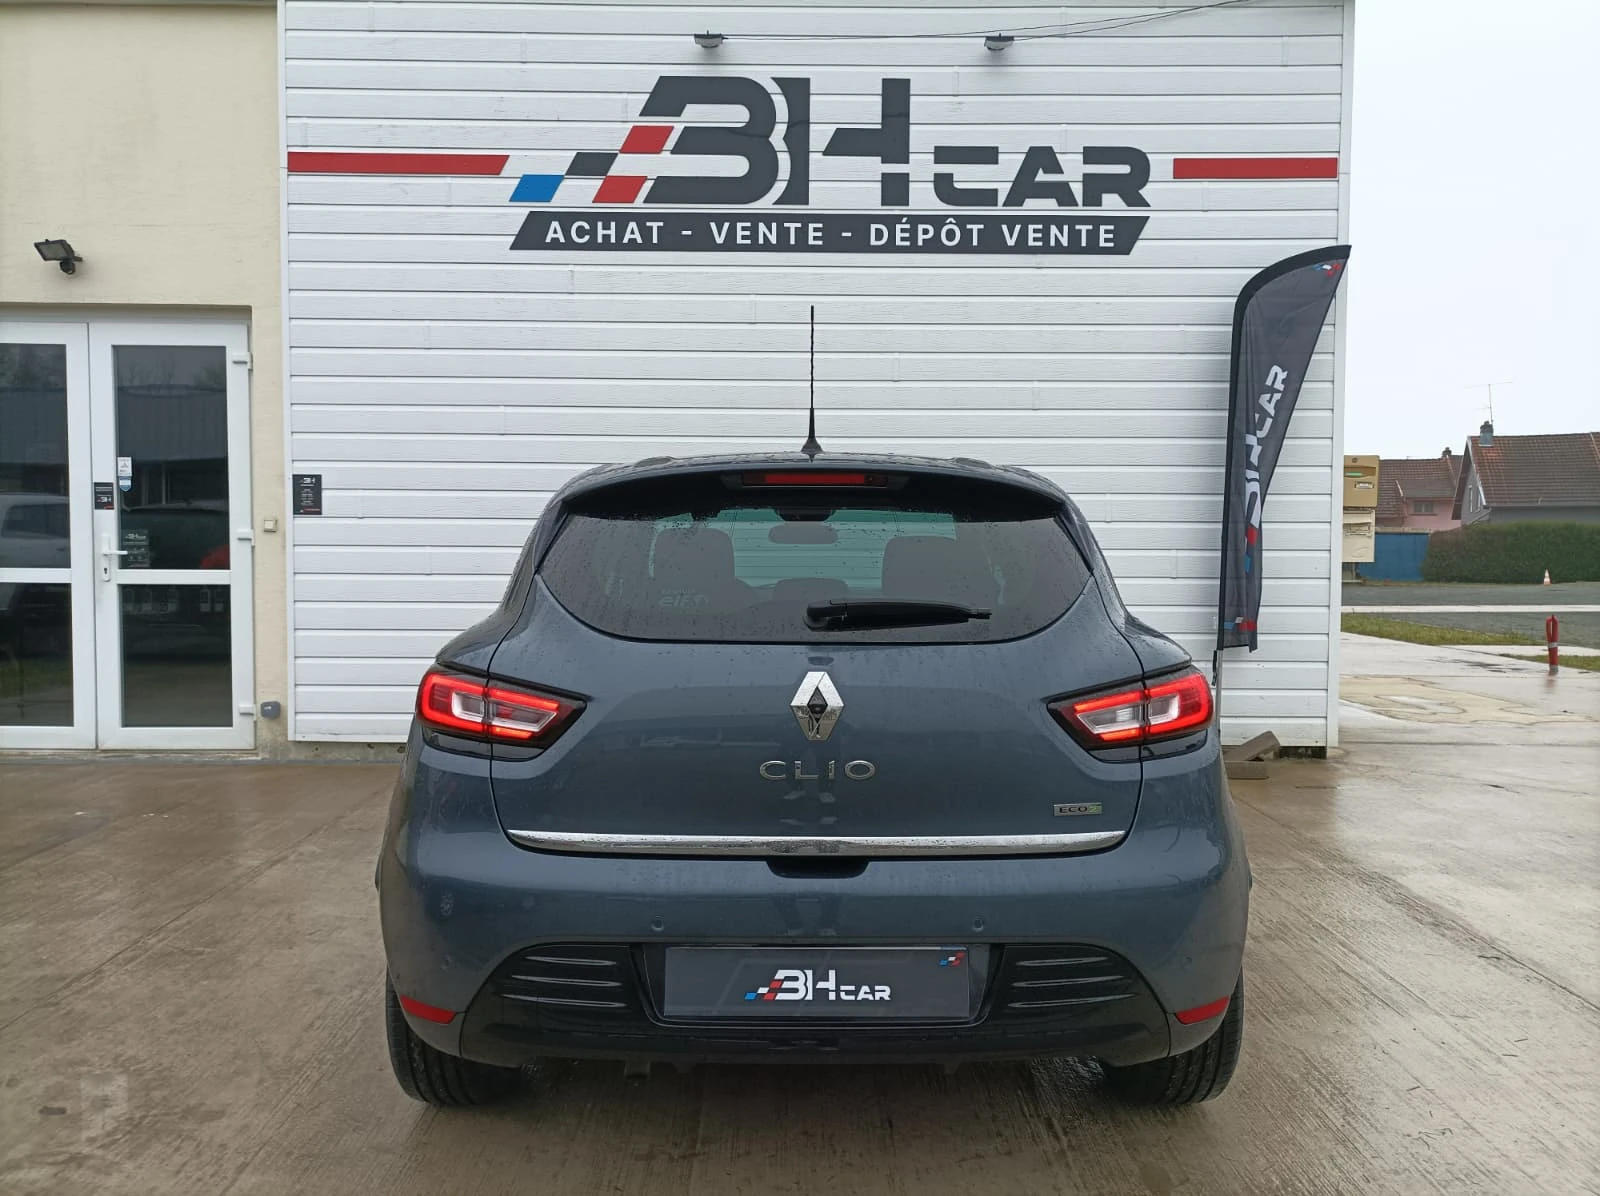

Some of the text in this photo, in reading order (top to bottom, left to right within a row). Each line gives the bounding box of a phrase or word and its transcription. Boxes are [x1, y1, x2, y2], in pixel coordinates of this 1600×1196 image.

[545, 221, 664, 244] ACHAT
[710, 222, 824, 245] VENTE
[869, 217, 985, 247] DÉPÔT
[1001, 224, 1115, 248] VENTE
[759, 760, 876, 780] CLIO
